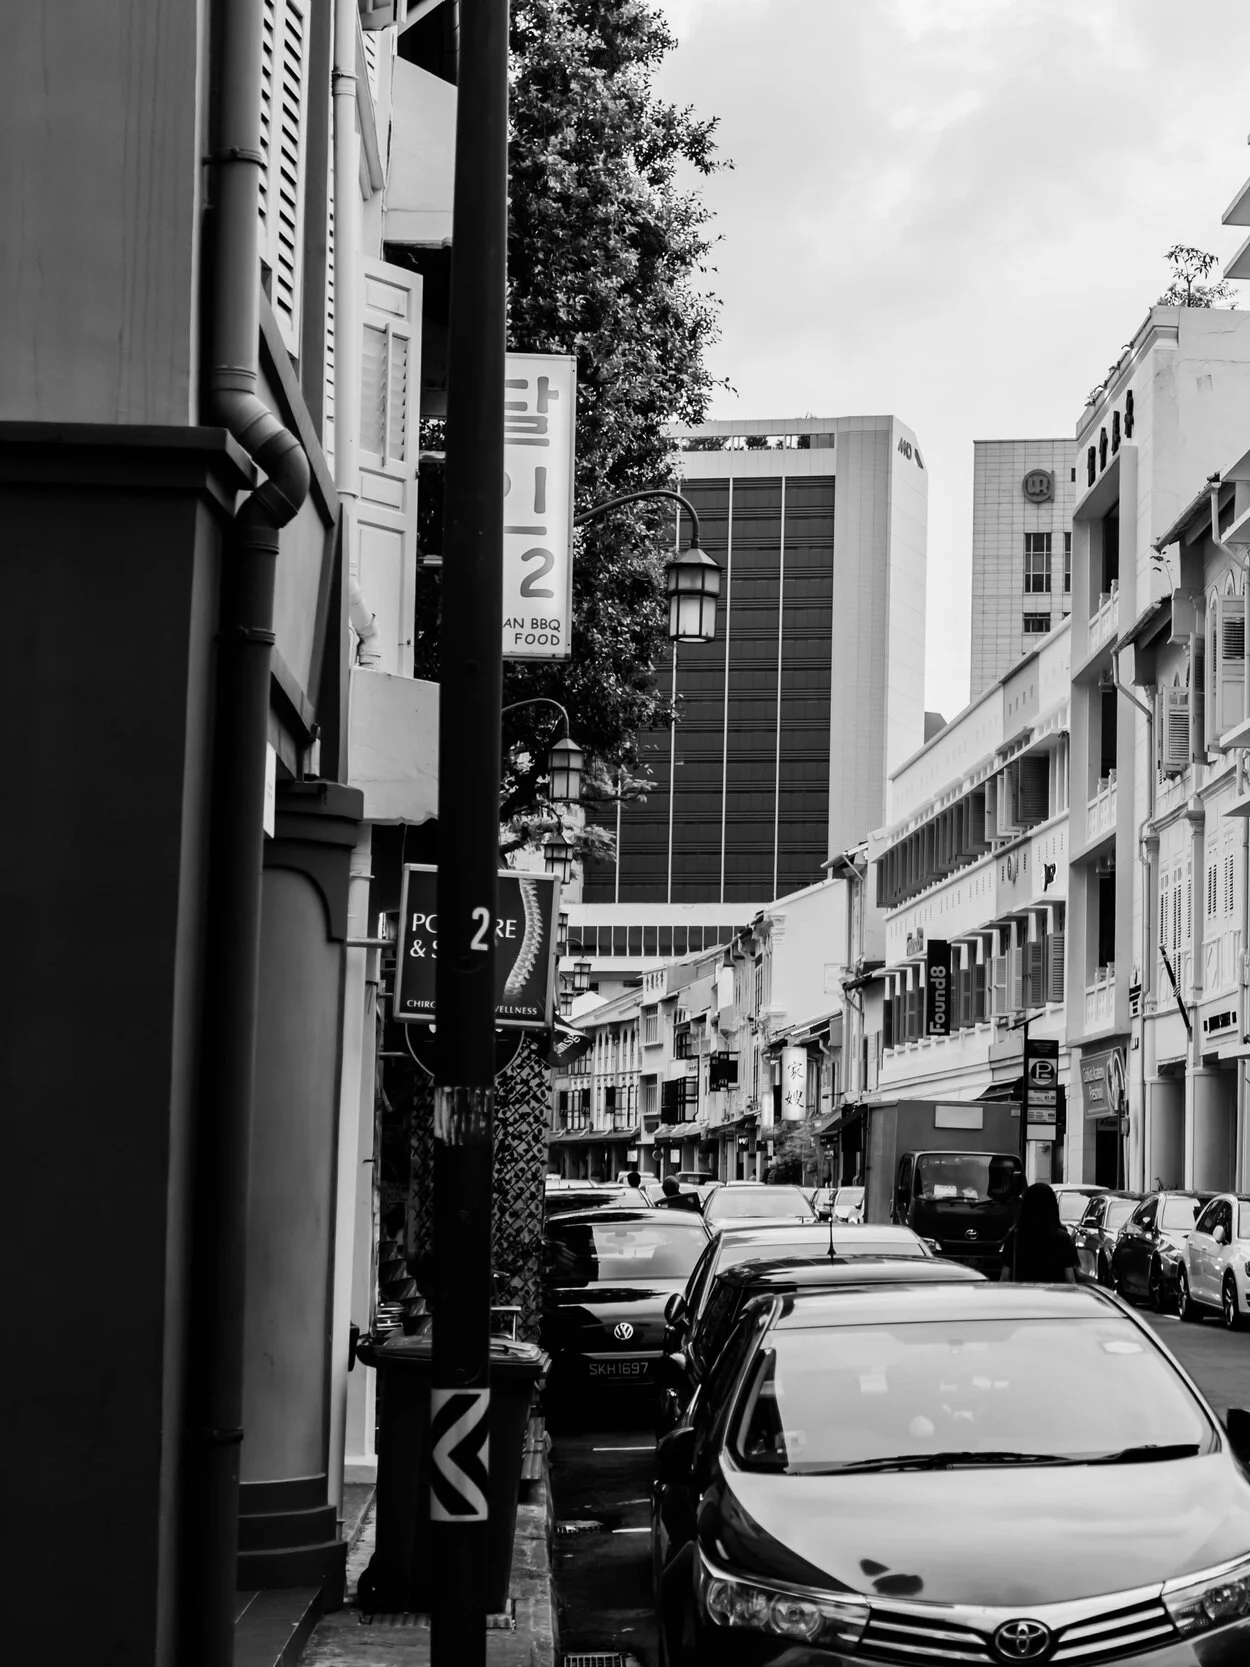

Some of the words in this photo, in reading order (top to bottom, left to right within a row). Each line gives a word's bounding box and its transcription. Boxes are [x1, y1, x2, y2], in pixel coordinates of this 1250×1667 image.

[531, 617, 561, 634] BBQ
[514, 633, 560, 646] FOOD
[470, 907, 490, 951] 2
[929, 965, 946, 1033] Found8
[495, 1005, 538, 1015] ELLNESS
[589, 1362, 649, 1375] SKH1697
